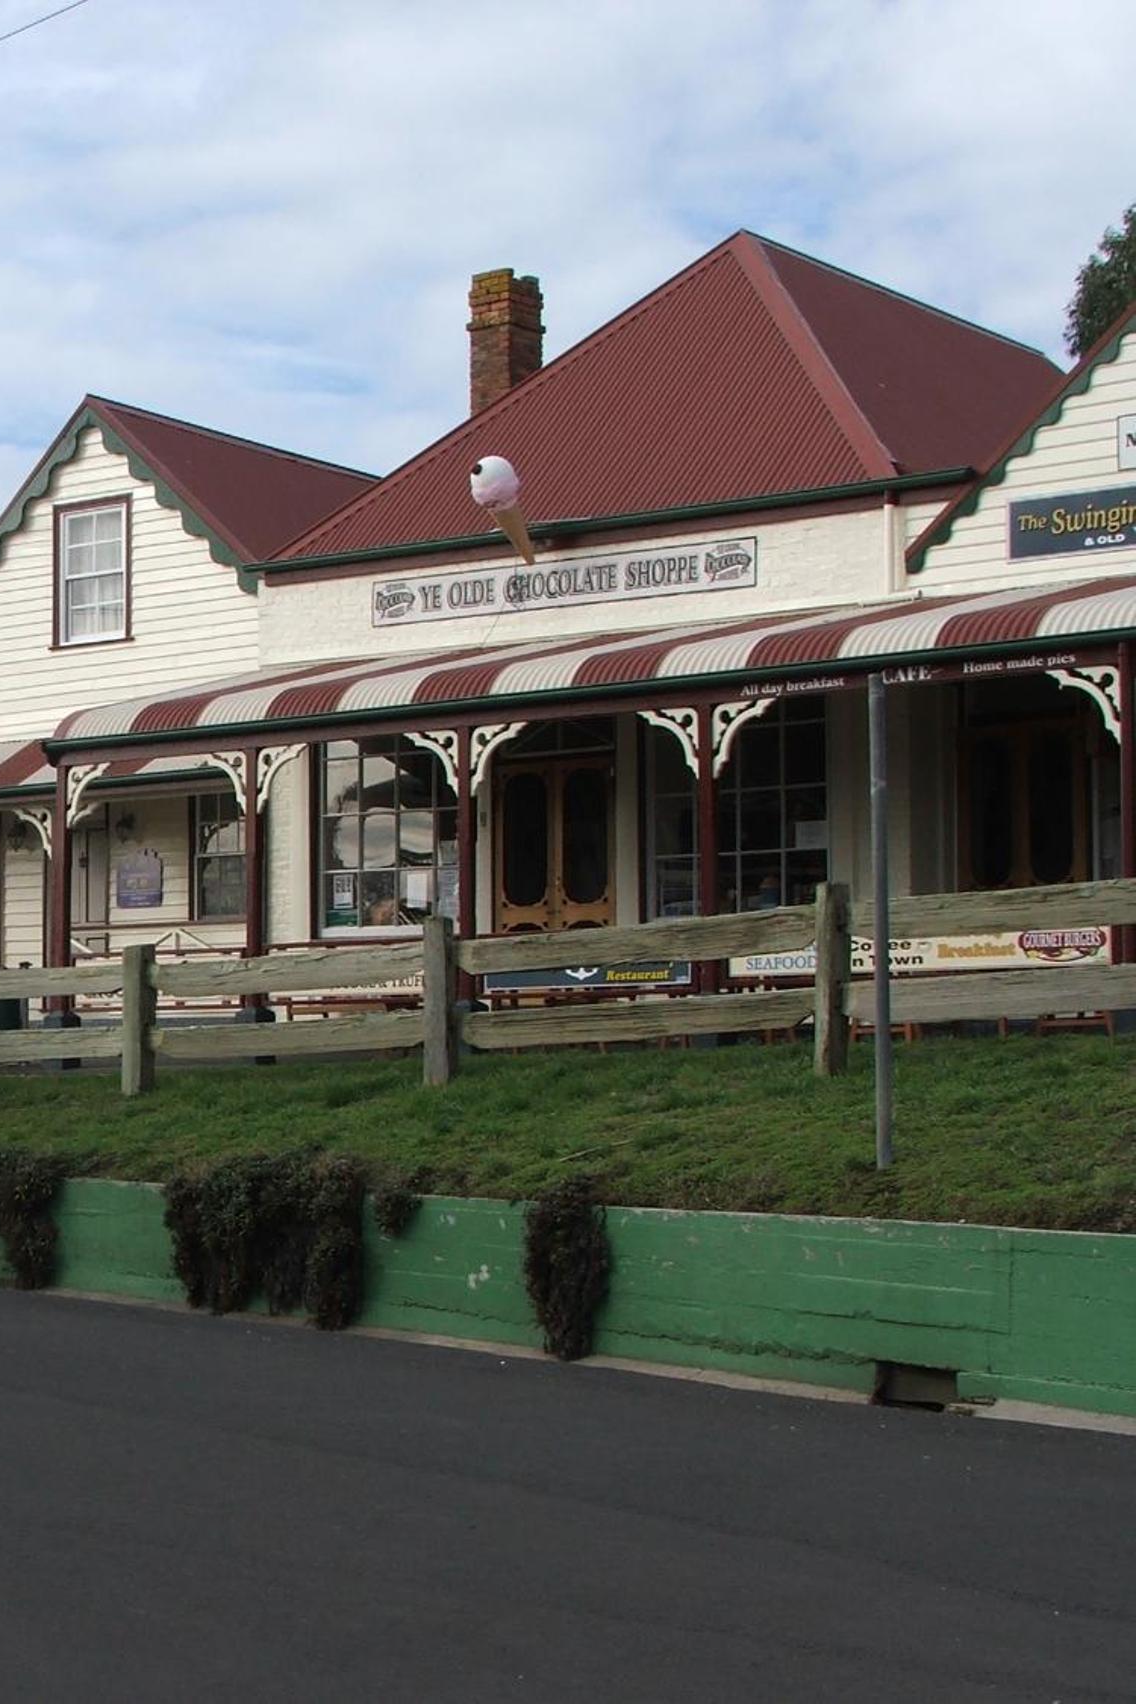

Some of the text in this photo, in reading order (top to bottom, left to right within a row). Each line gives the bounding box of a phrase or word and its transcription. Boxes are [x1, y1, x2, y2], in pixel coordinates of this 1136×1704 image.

[1017, 514, 1048, 532] The
[1097, 534, 1126, 545] OLD
[418, 585, 442, 611] YE
[447, 578, 496, 609] OLDE
[504, 564, 617, 605] CHOCOLATE
[624, 556, 699, 590] SHOPPE
[963, 653, 1076, 673] Home made pies
[740, 678, 844, 696] All day breakfast
[1064, 930, 1101, 946] BURGERS
[606, 969, 670, 982] Restaurant
